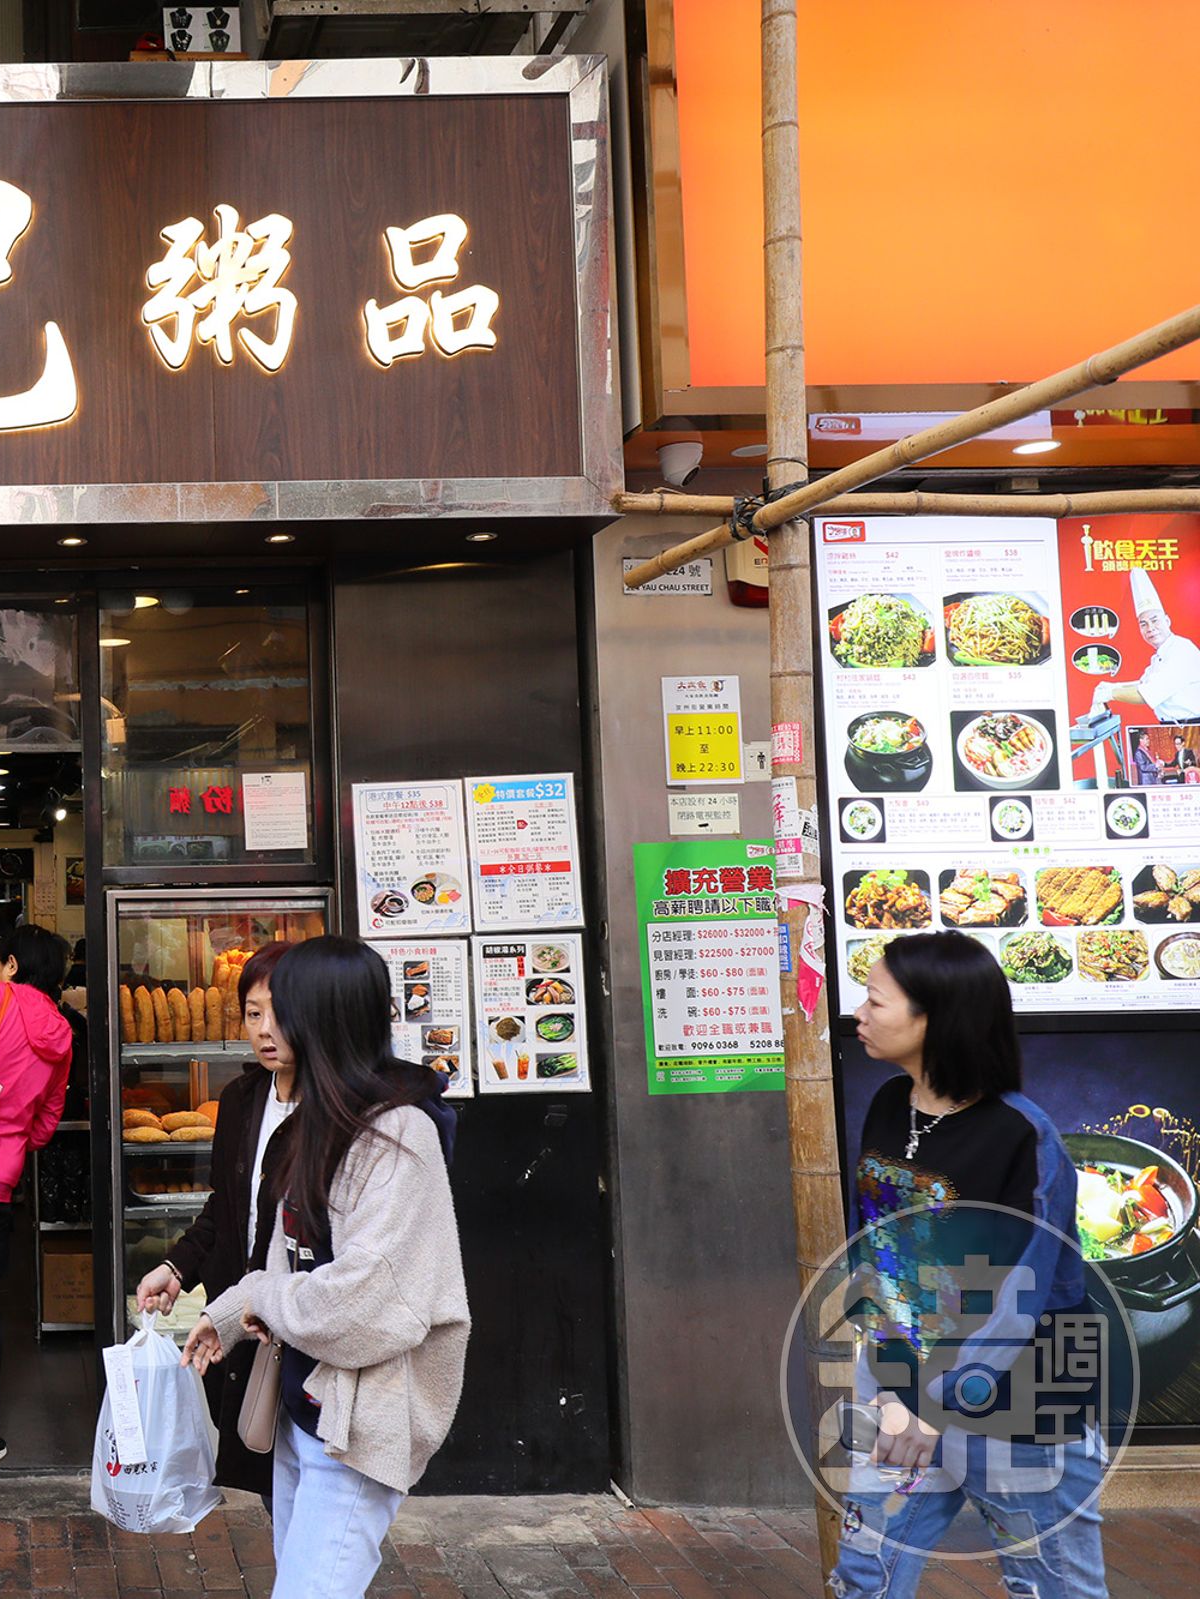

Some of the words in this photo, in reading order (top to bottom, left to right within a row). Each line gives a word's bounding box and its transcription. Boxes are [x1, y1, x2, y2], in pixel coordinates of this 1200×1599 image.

[1093, 538, 1179, 560] 飲食天王
[658, 584, 680, 592] CHAU
[700, 744, 709, 754] 至
[535, 782, 563, 798] $32
[664, 866, 774, 895] 擴充營業
[652, 930, 696, 942] 分店經理:
[697, 929, 728, 939] $26000
[734, 927, 765, 937] $32000
[653, 949, 697, 961] 見習經理:
[699, 948, 733, 958] $22500
[740, 946, 774, 957] $27000
[700, 967, 718, 978] $60
[725, 967, 743, 977] $80
[701, 987, 719, 997] $60
[726, 986, 745, 996] $75
[702, 1007, 720, 1017] $60
[728, 1006, 746, 1016] $75
[682, 1021, 773, 1037] 歡迎全職或兼職
[691, 1041, 714, 1050] 9096
[716, 1040, 739, 1049] 0368
[750, 1040, 773, 1048] 5208
